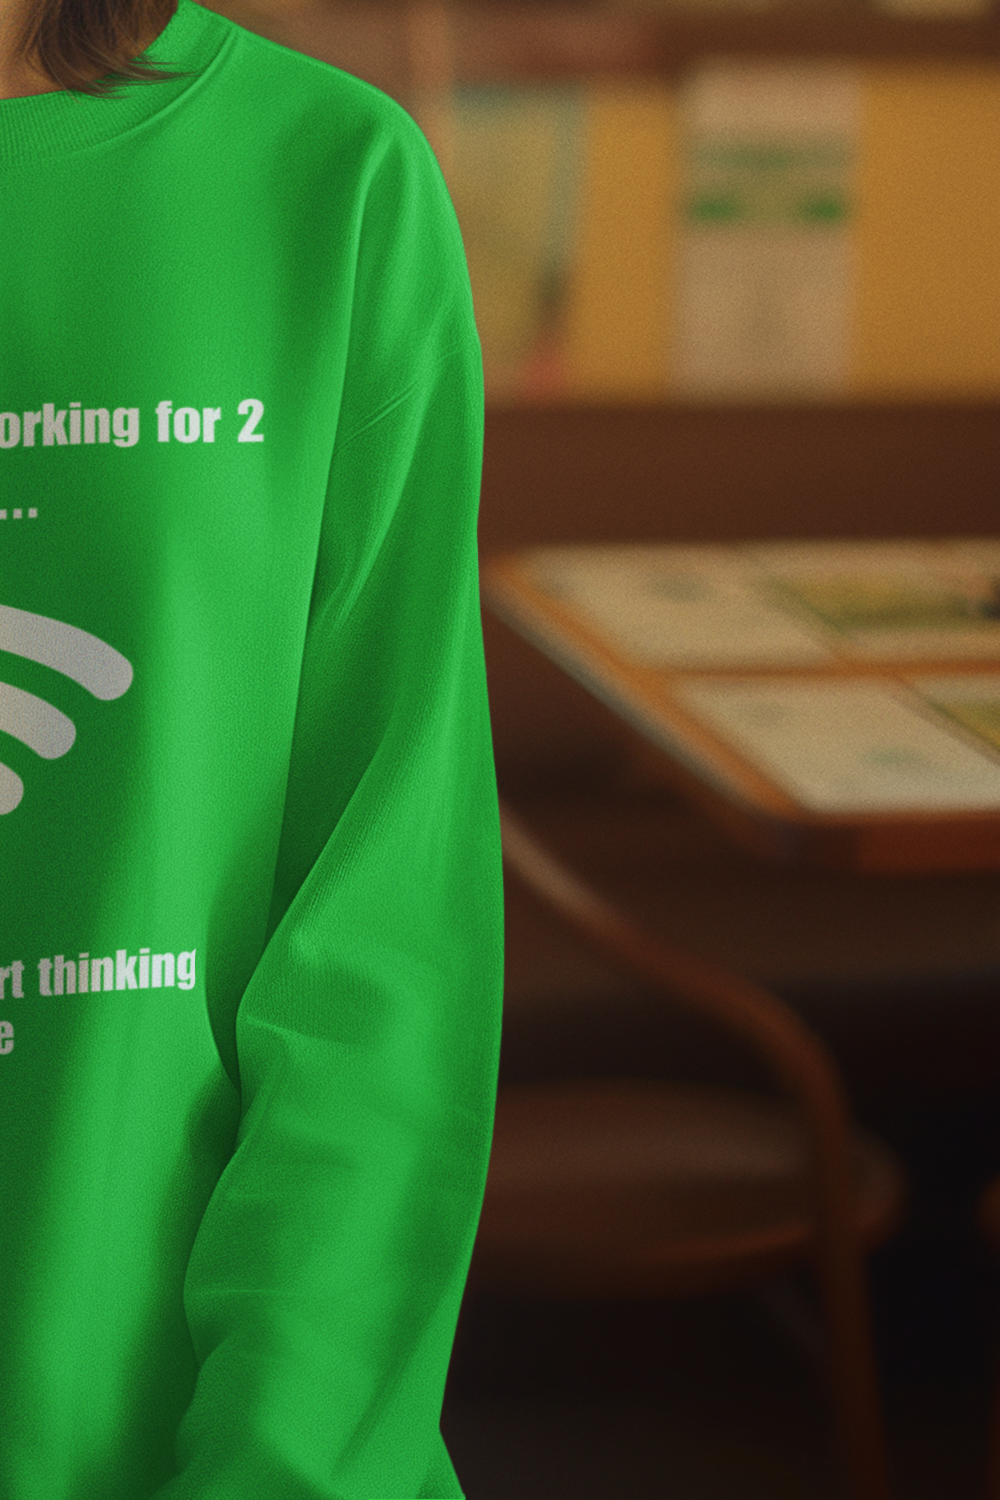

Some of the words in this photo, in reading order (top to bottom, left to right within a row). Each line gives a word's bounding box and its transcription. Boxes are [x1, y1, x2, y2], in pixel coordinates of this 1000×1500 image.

[156, 400, 222, 444] for
[237, 398, 265, 443] 2
[38, 947, 197, 996] thinking
